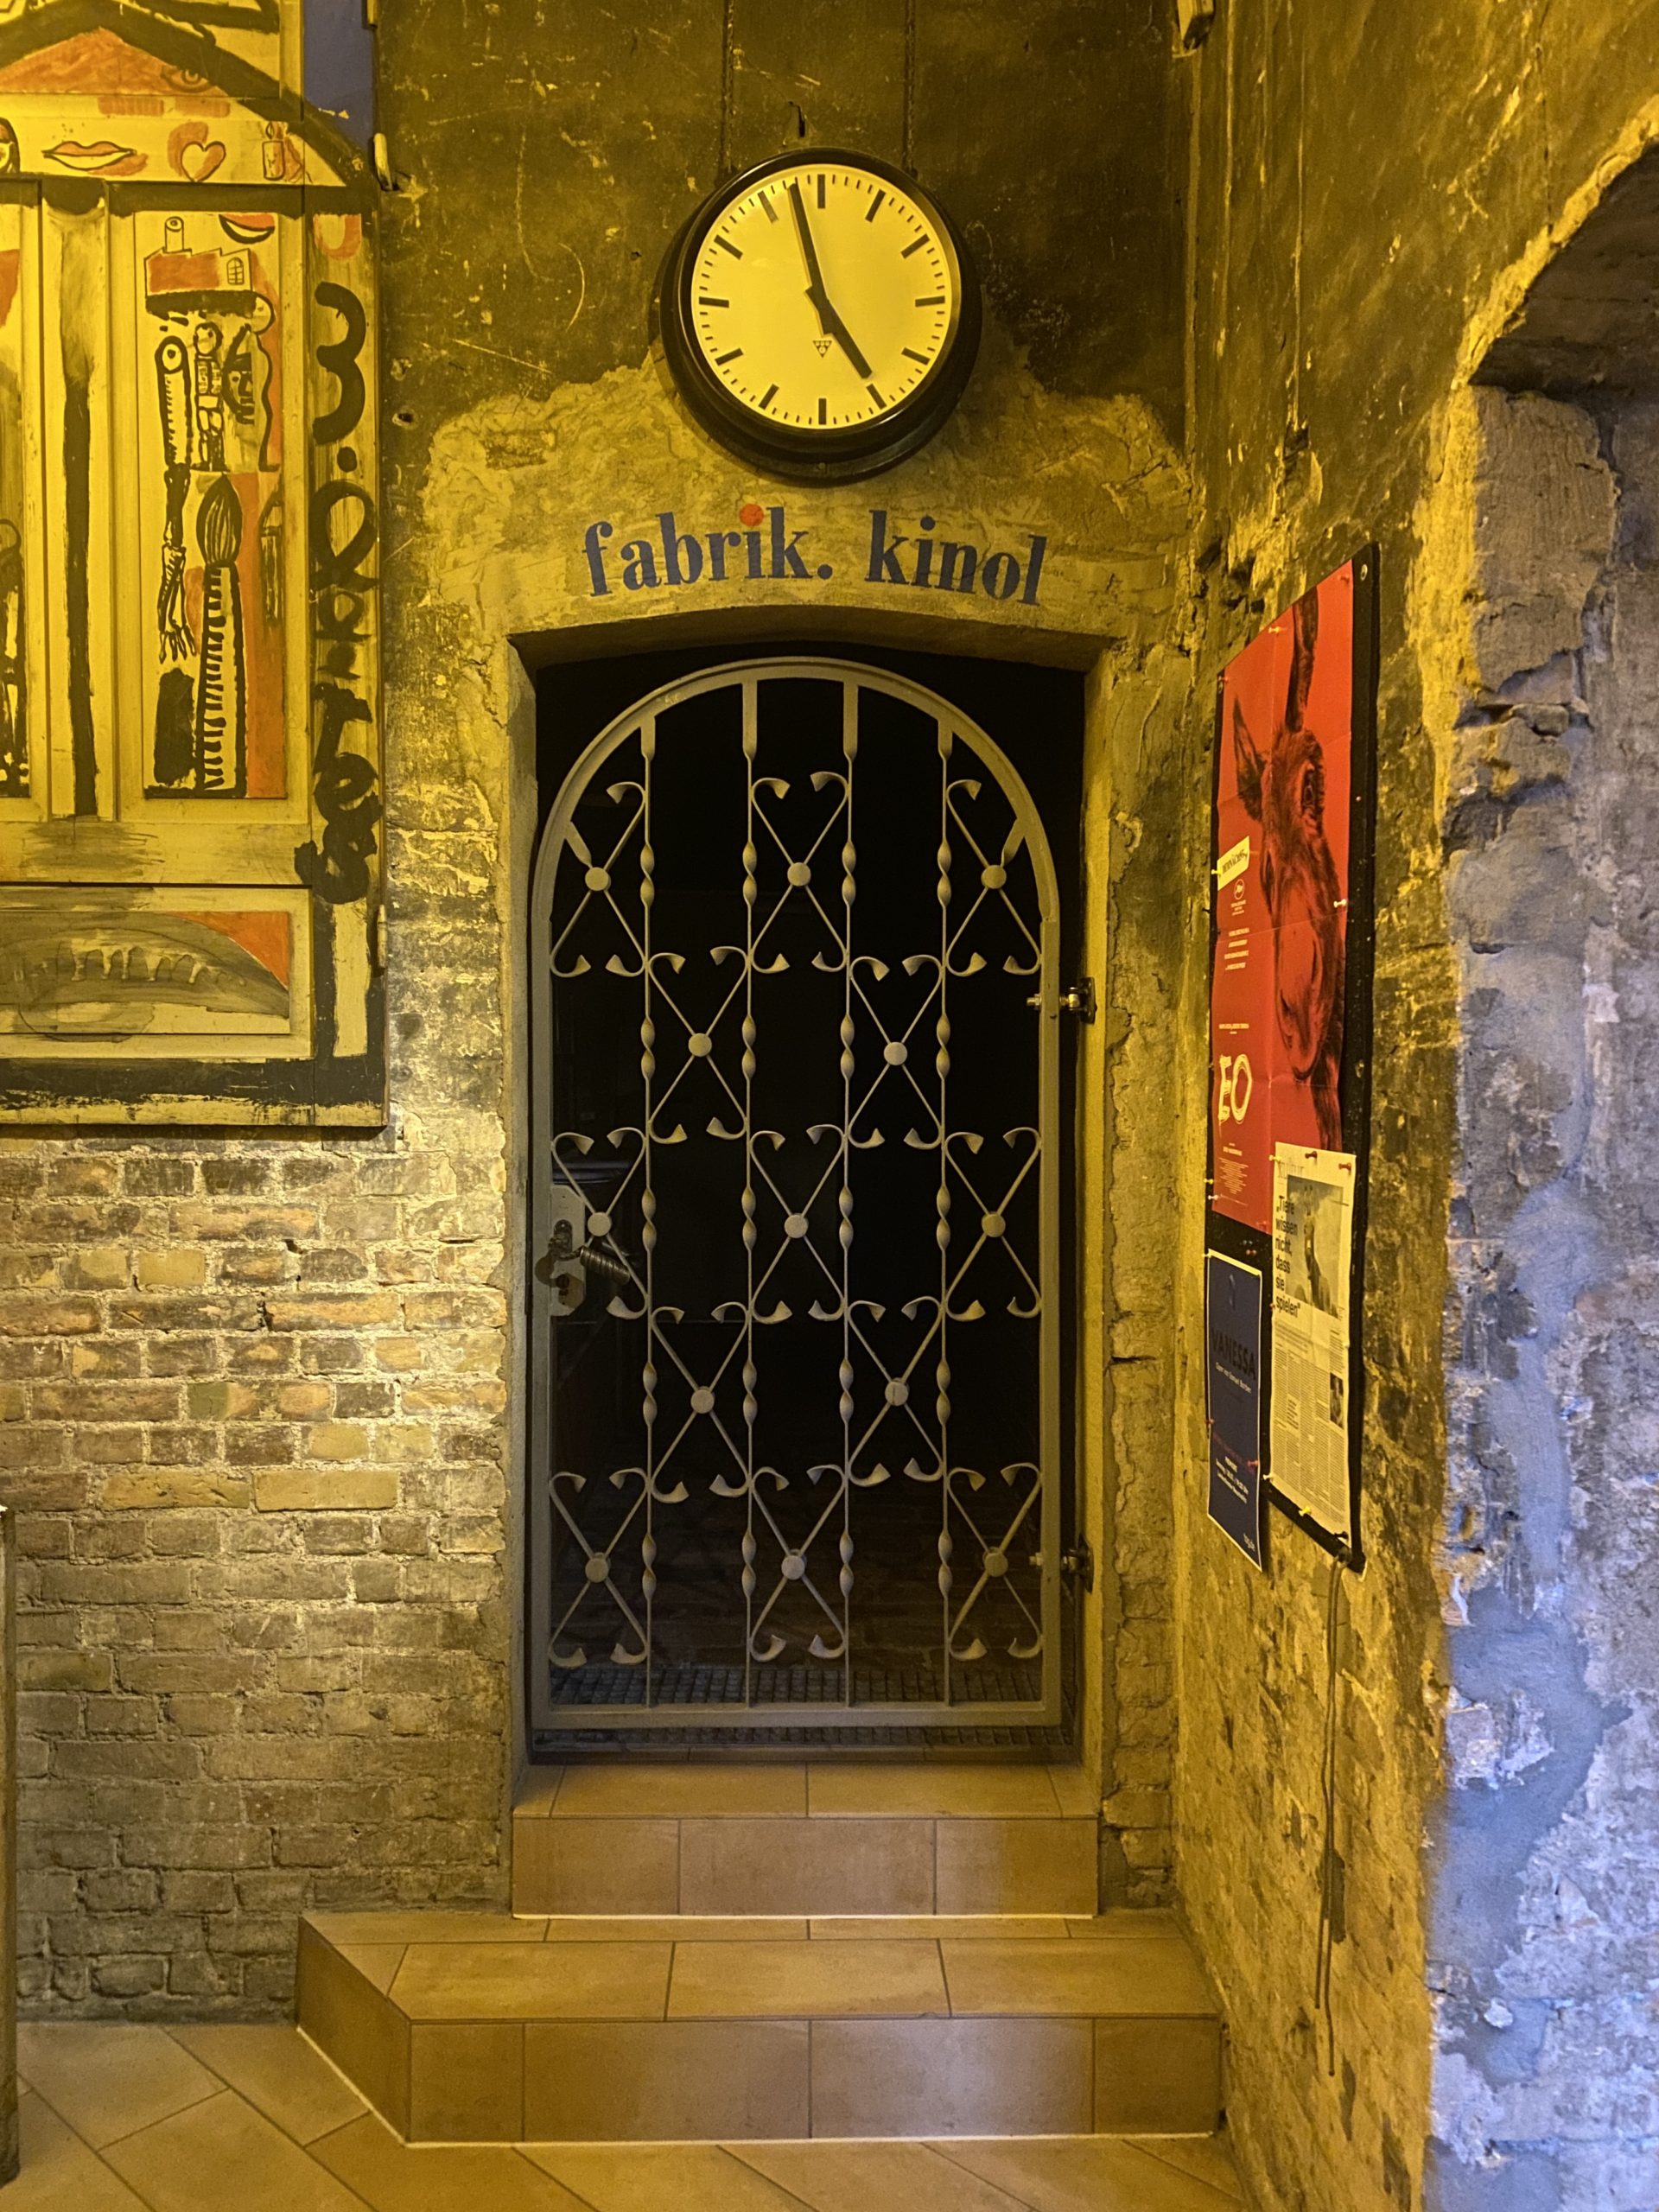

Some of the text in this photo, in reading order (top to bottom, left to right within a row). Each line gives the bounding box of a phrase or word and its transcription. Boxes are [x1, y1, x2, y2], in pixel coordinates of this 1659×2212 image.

[582, 504, 834, 597] fabrik.
[1217, 1054, 1253, 1124] EO
[1275, 1215, 1299, 1236] wissen
[1274, 1273, 1285, 1292] sie
[1275, 1254, 1292, 1274] dass
[1211, 1325, 1257, 1381] VANESSA
